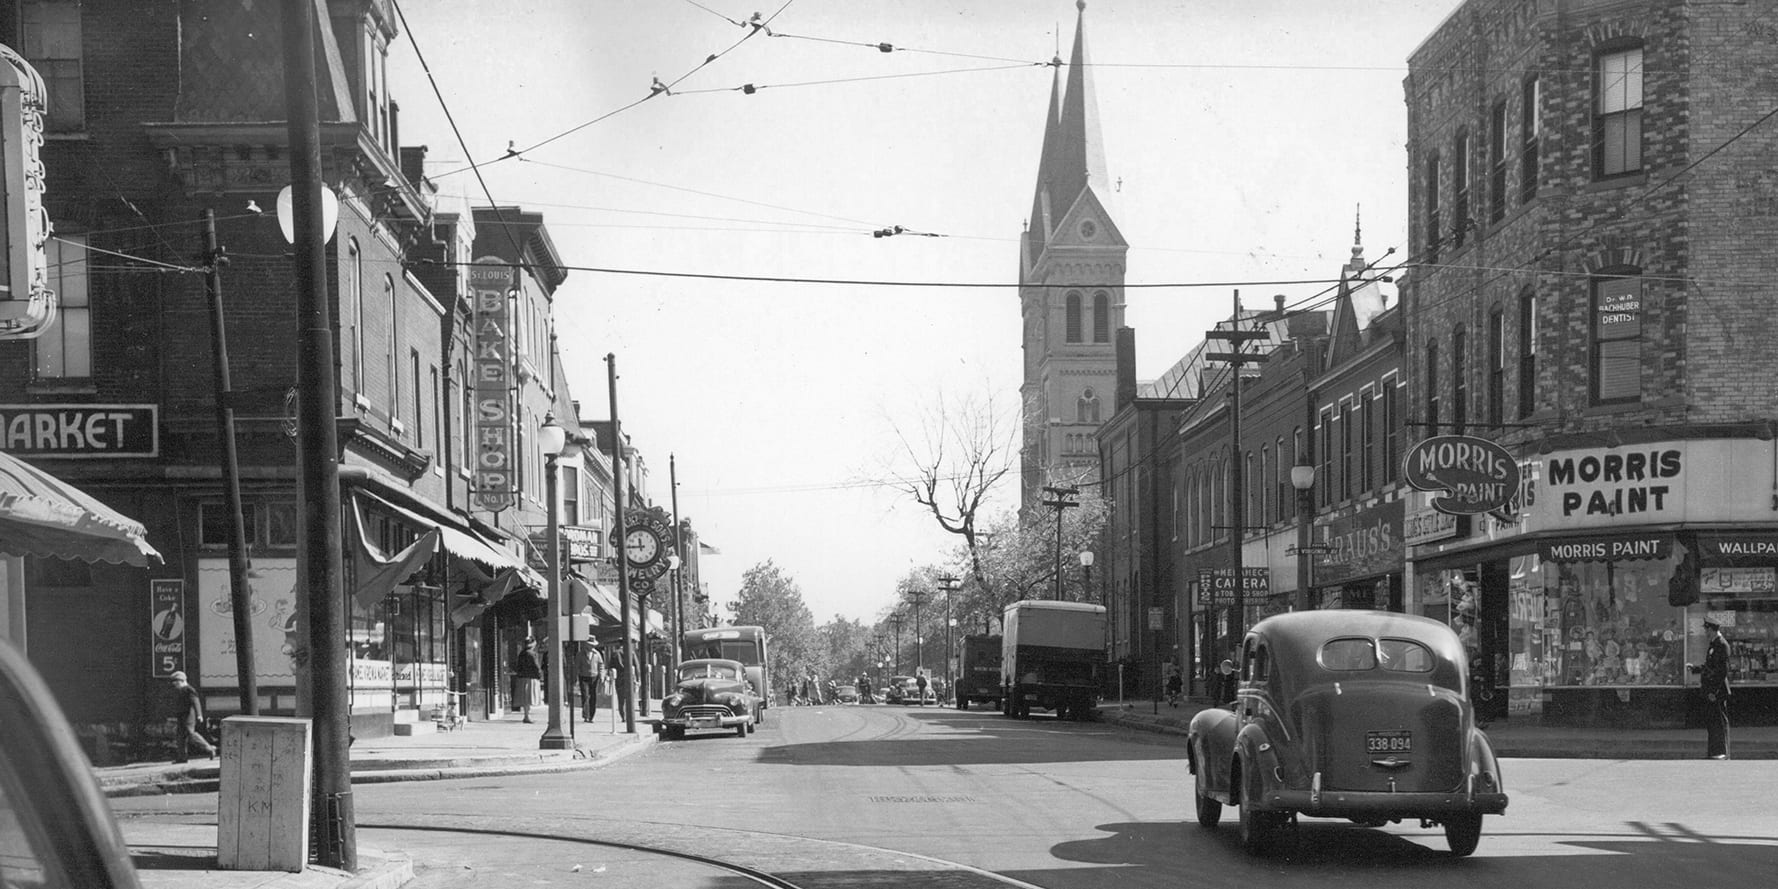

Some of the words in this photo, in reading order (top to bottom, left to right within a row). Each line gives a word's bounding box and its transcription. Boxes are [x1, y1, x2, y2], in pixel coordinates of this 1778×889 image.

[482, 270, 511, 280] LOUIS
[1603, 314, 1635, 324] DENTIST
[478, 289, 504, 382] BAKE
[0, 412, 133, 450] ARKET
[478, 399, 506, 491] SHOP
[1420, 443, 1508, 480] MORRIS
[1549, 449, 1682, 486] MORRIS
[1457, 482, 1508, 503] PAINT
[1563, 486, 1669, 516] PAINT
[650, 520, 672, 543] SONS
[1551, 543, 1606, 559] MORRIS
[1613, 540, 1660, 556] PAINT
[1719, 542, 1778, 554] WALLPA
[626, 557, 667, 580] WELRY
[1215, 577, 1268, 589] CAERA
